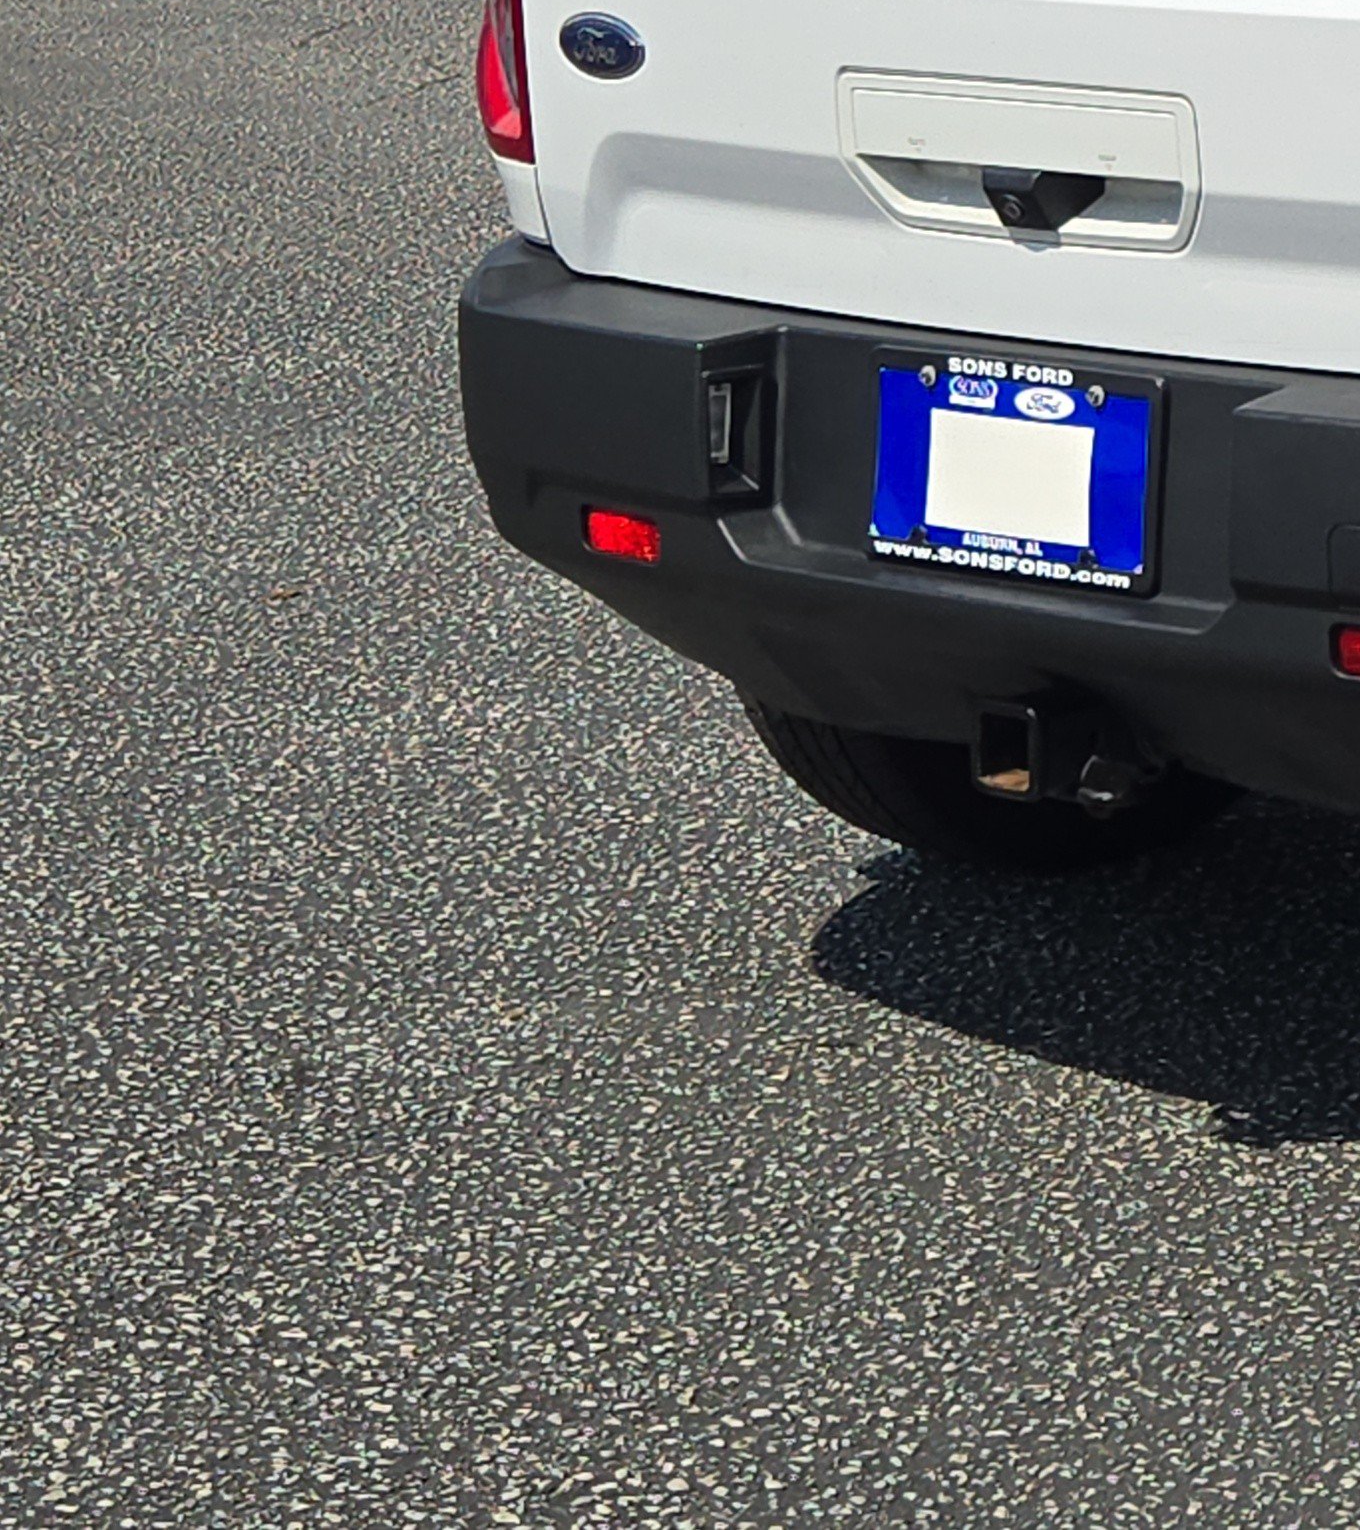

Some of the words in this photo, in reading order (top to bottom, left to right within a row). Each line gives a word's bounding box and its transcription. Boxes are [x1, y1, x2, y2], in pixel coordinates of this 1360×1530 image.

[947, 356, 1008, 379] SONS
[1011, 362, 1074, 387] FORD
[1025, 392, 1062, 415] Ford
[1024, 540, 1043, 557] AL
[872, 539, 1132, 590] www.SONSFORD.com
